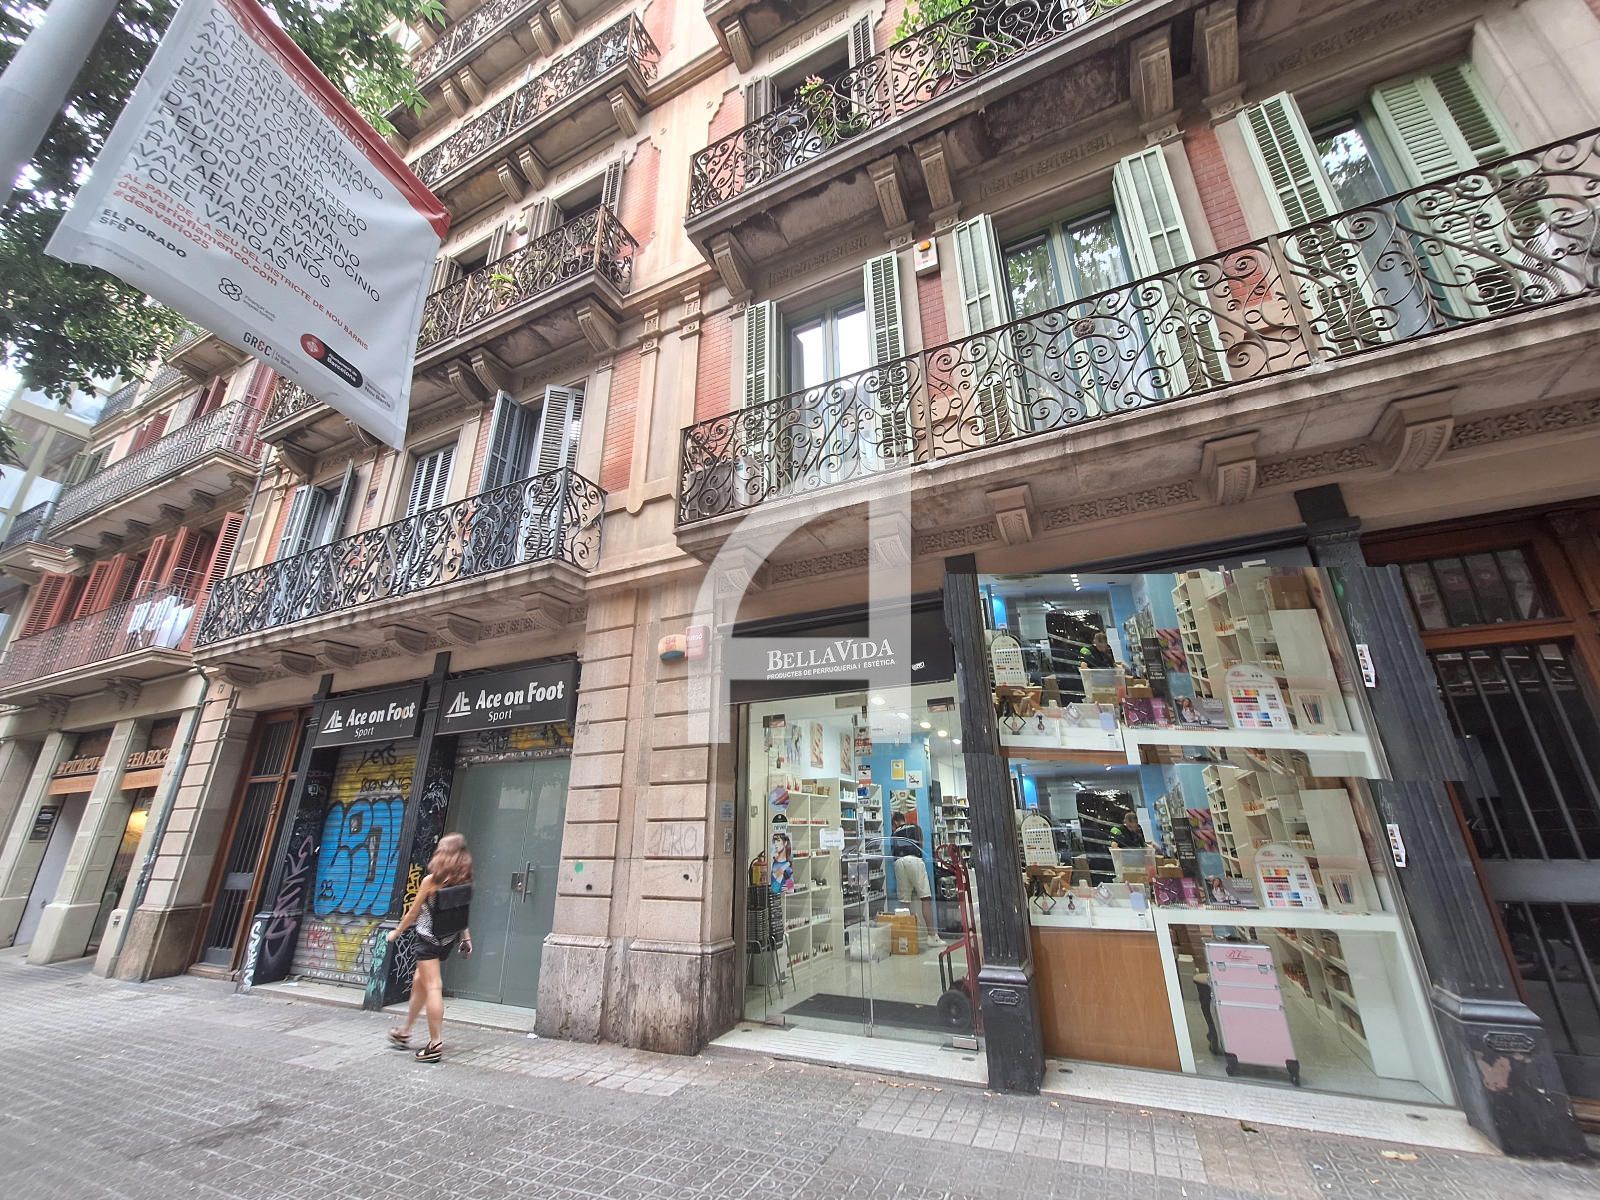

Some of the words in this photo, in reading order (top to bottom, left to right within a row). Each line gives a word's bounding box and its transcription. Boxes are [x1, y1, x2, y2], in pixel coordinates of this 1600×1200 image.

[184, 57, 258, 117] JAVIER
[264, 117, 324, 182] COLINA
[190, 45, 268, 110] JOSEMI
[272, 112, 351, 195] CARMONA
[197, 33, 283, 114] ANTONIO
[287, 116, 363, 192] SERRANO
[203, 21, 312, 127] ALEJANDRO
[316, 127, 383, 200] HURTADO
[211, 8, 282, 84] CARLES
[289, 84, 346, 147] TREPAT
[308, 91, 328, 114] DE
[328, 112, 371, 159] JULIOL
[140, 142, 267, 237] VALERIANO
[144, 130, 236, 198] RAFAEL
[241, 195, 325, 268] ESTÉVEZ
[158, 104, 241, 165] PEDRO
[247, 166, 270, 192] EL
[165, 90, 235, 143] DAVID
[241, 144, 269, 173] DE
[271, 173, 338, 236] ARAHAL
[172, 79, 261, 153] SANDRA
[267, 151, 358, 237] CARRASCO
[178, 65, 272, 146] PATRICIA
[278, 145, 367, 231] GUERRERO
[99, 216, 128, 233] SFB
[102, 208, 121, 221] EL
[124, 216, 187, 258] DORADO
[113, 189, 209, 250] #desvario25
[117, 180, 277, 287] desvarioflamenco.com
[124, 173, 141, 185] AL
[145, 182, 174, 204] PATI
[176, 202, 193, 217] DE
[196, 216, 211, 231] LA
[215, 228, 239, 247] SEU
[241, 246, 261, 265] DEL
[263, 262, 312, 302] DISTRICTE
[312, 299, 325, 312] DE
[325, 309, 343, 327] NOU
[343, 324, 369, 351] BARRIS
[132, 157, 196, 208] YOEL
[205, 203, 288, 270] VARGAS
[149, 120, 256, 193] ANTONIO
[261, 193, 288, 221] DE
[292, 219, 380, 302] PATROCINIO
[345, 708, 368, 727] Ace
[368, 709, 386, 723] on
[386, 702, 416, 722] Foot
[475, 689, 502, 710] Ace
[503, 689, 525, 706] on
[527, 680, 565, 703] Foot
[487, 708, 513, 723] Sport
[766, 670, 802, 680] PRODUCTES
[812, 663, 857, 675] PERRUQUERIA
[353, 726, 375, 739] Sport
